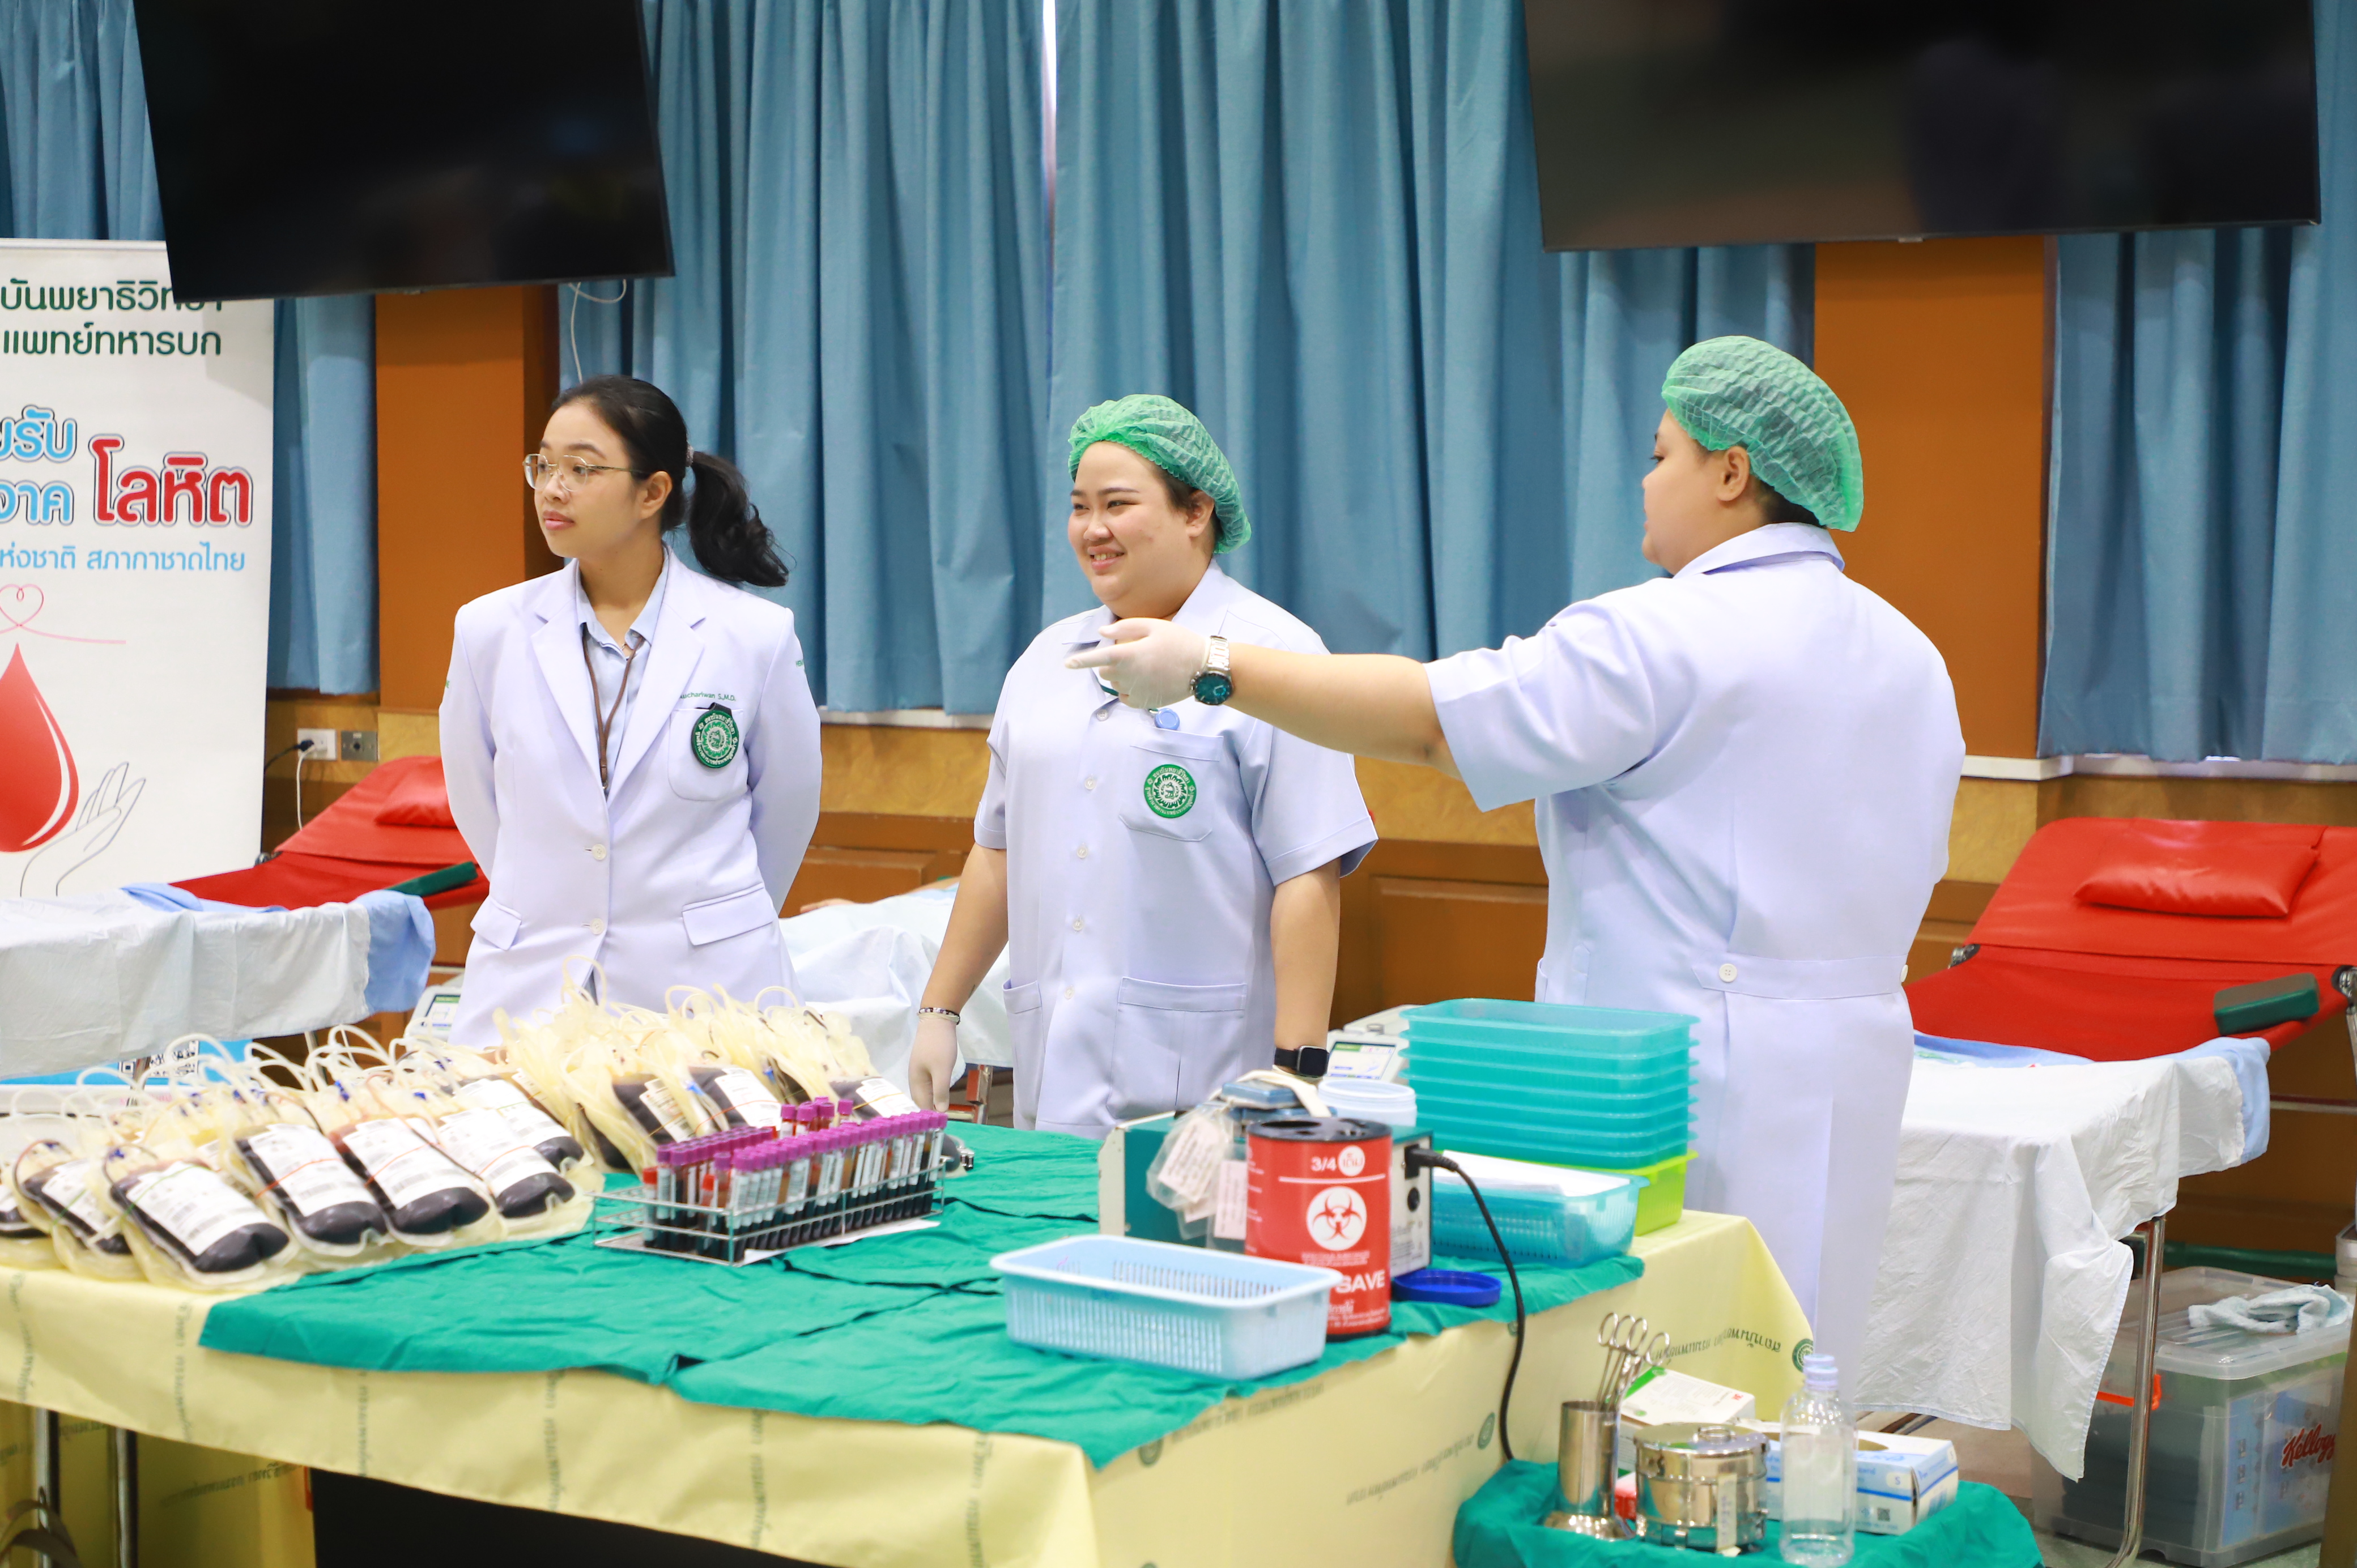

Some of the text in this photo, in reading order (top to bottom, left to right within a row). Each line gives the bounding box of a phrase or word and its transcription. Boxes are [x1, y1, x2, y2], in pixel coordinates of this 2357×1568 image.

[1, 278, 222, 311] บันพยาธิวิท
[3, 321, 222, 355] แพทย์ทหารบก
[90, 435, 252, 526] โลหิต
[87, 541, 245, 572] สภากาชาดไทย
[1311, 1157, 1337, 1172] 3/4
[1335, 1269, 1386, 1293] SAVE
